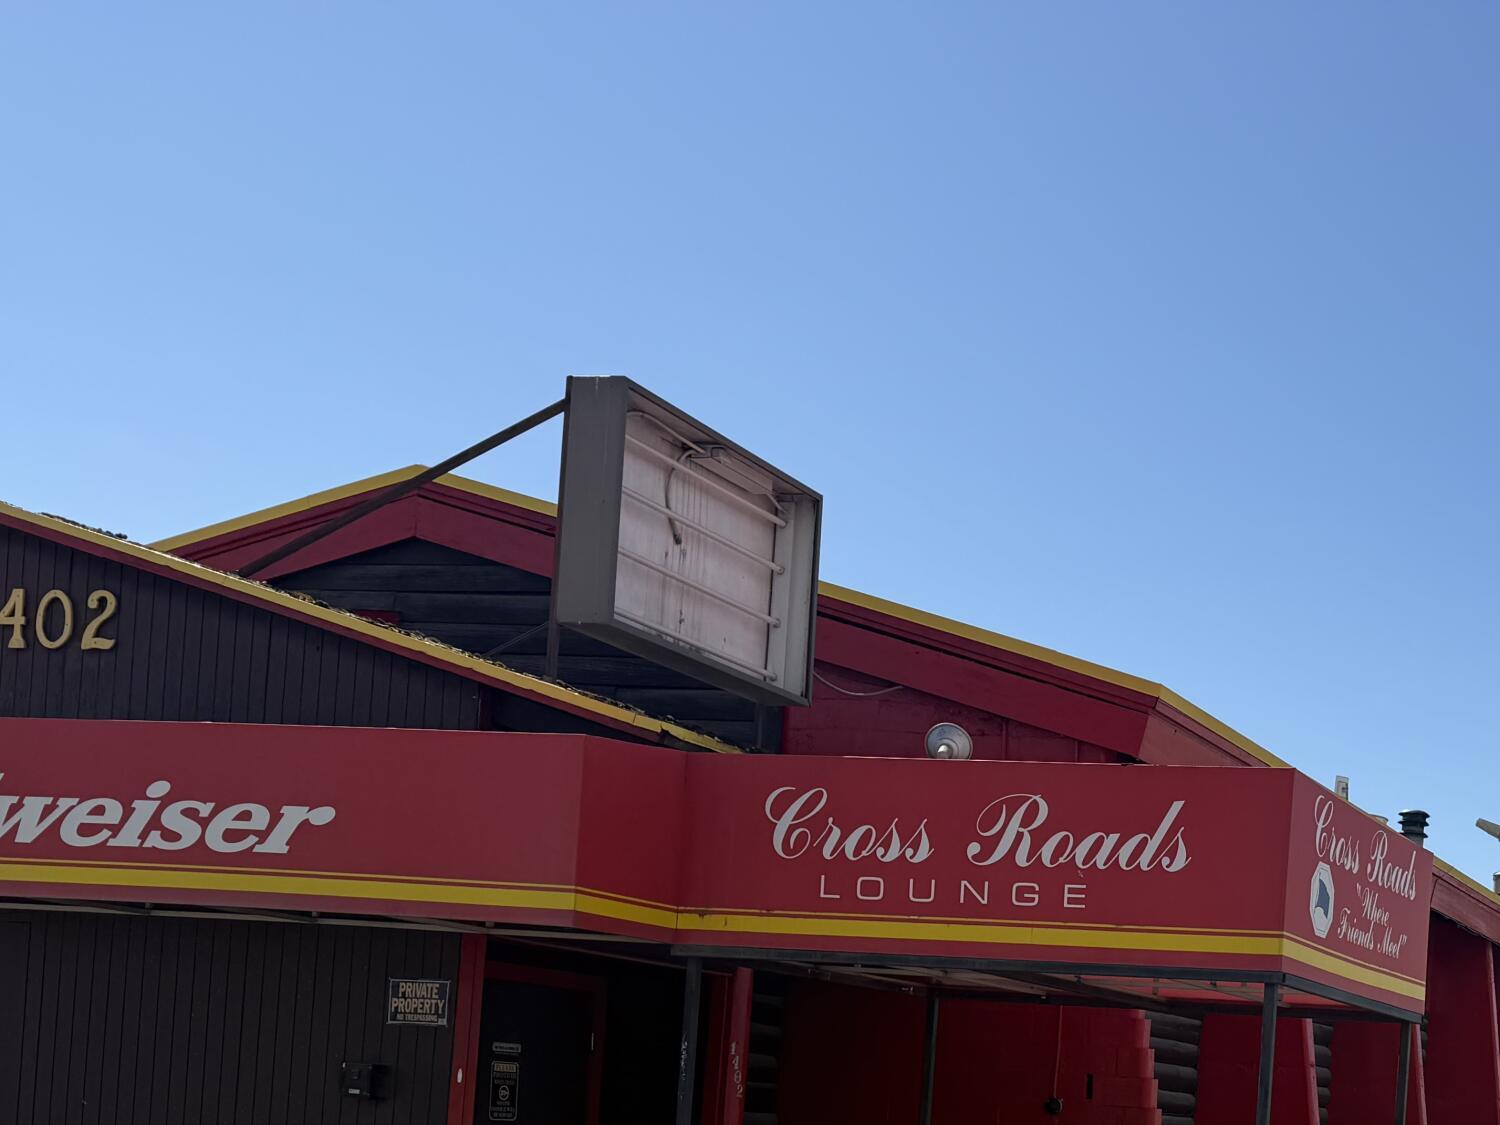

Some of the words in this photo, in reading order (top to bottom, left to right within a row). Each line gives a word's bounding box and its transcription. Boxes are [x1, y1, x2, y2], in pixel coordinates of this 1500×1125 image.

[0, 588, 117, 650] 402
[0, 773, 336, 854] weiser
[765, 786, 935, 863] Cross
[966, 793, 1192, 873] Roads
[1314, 794, 1360, 874] Cross
[1367, 830, 1416, 900] Roads
[820, 875, 1087, 908] LOUNGE
[1337, 907, 1374, 951] Friends
[391, 997, 444, 1014] PROPERTY
[399, 982, 439, 998] PRIVATE
